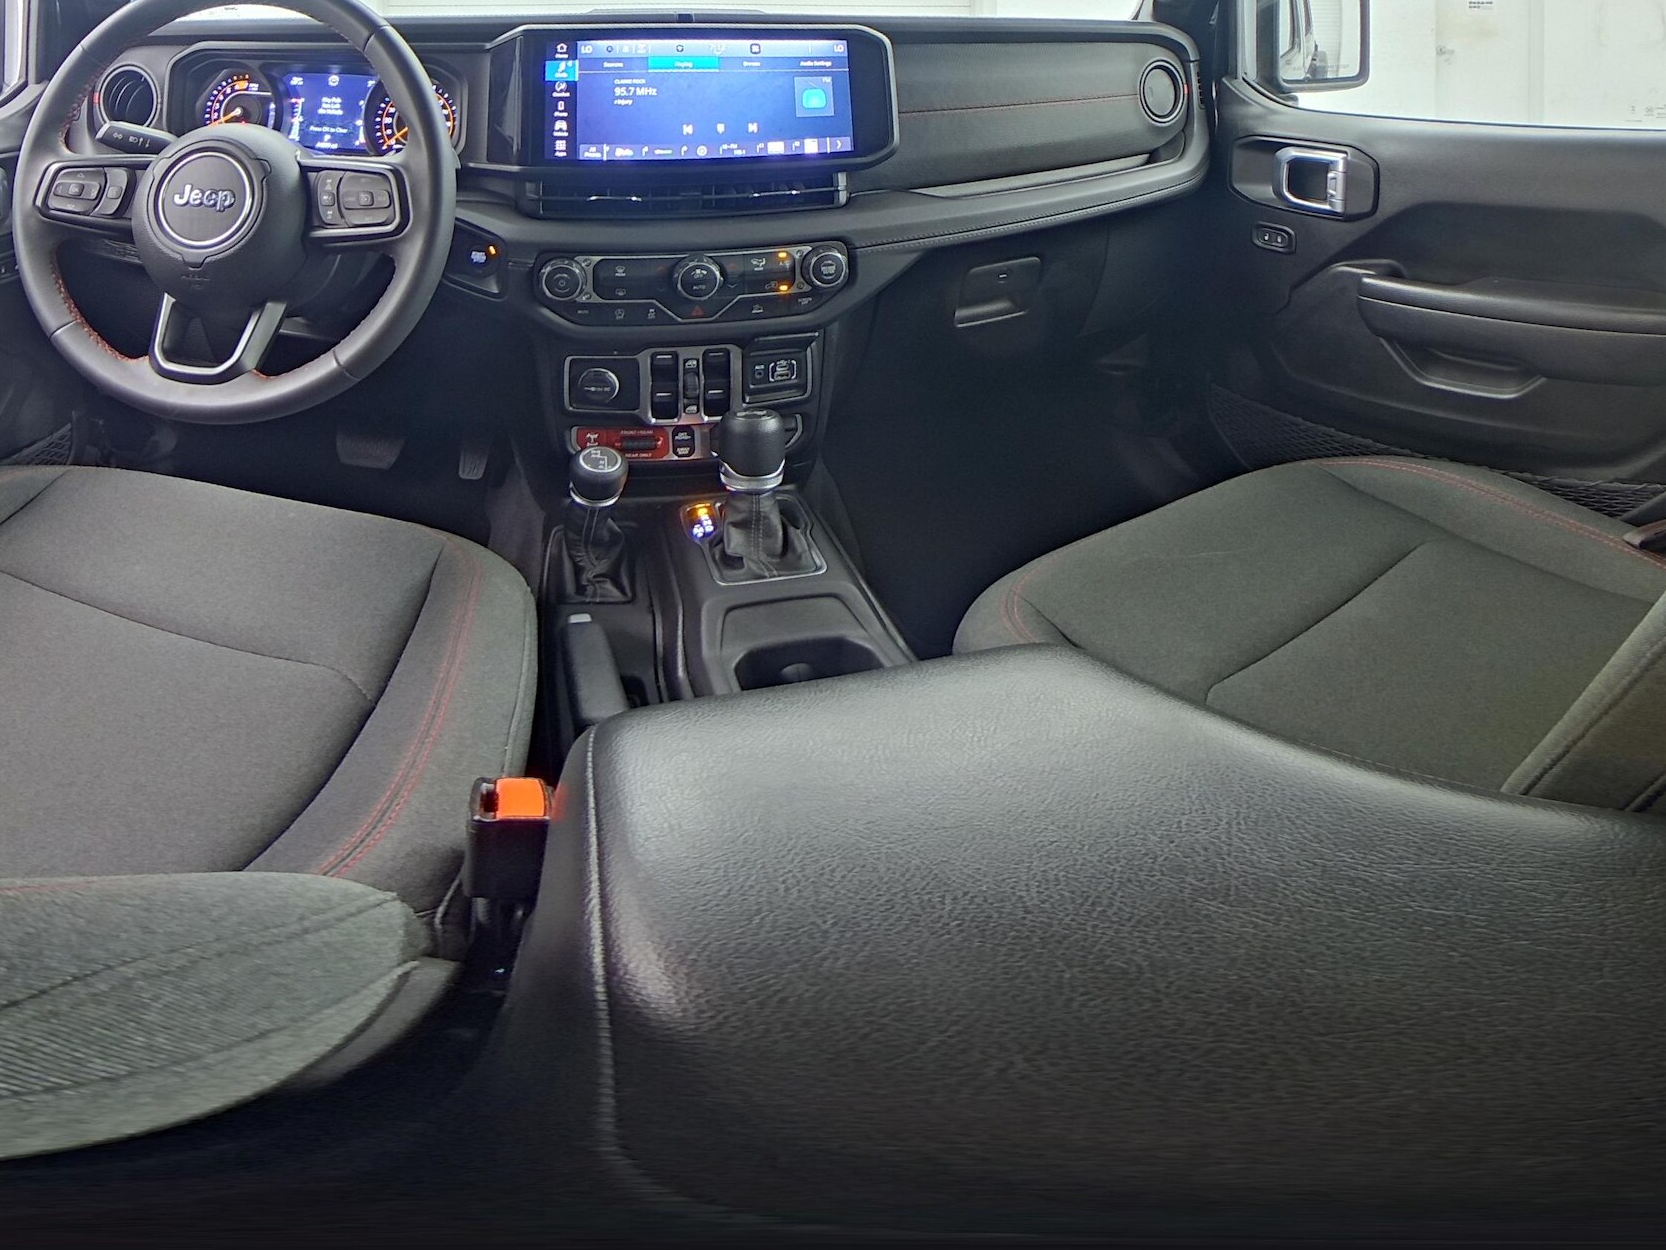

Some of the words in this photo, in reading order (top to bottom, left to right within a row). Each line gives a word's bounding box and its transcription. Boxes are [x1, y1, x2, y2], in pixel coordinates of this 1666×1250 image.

[580, 45, 593, 54] LO
[614, 87, 635, 96] 95.7
[636, 87, 658, 96] MHz
[173, 184, 236, 213] Jeep
